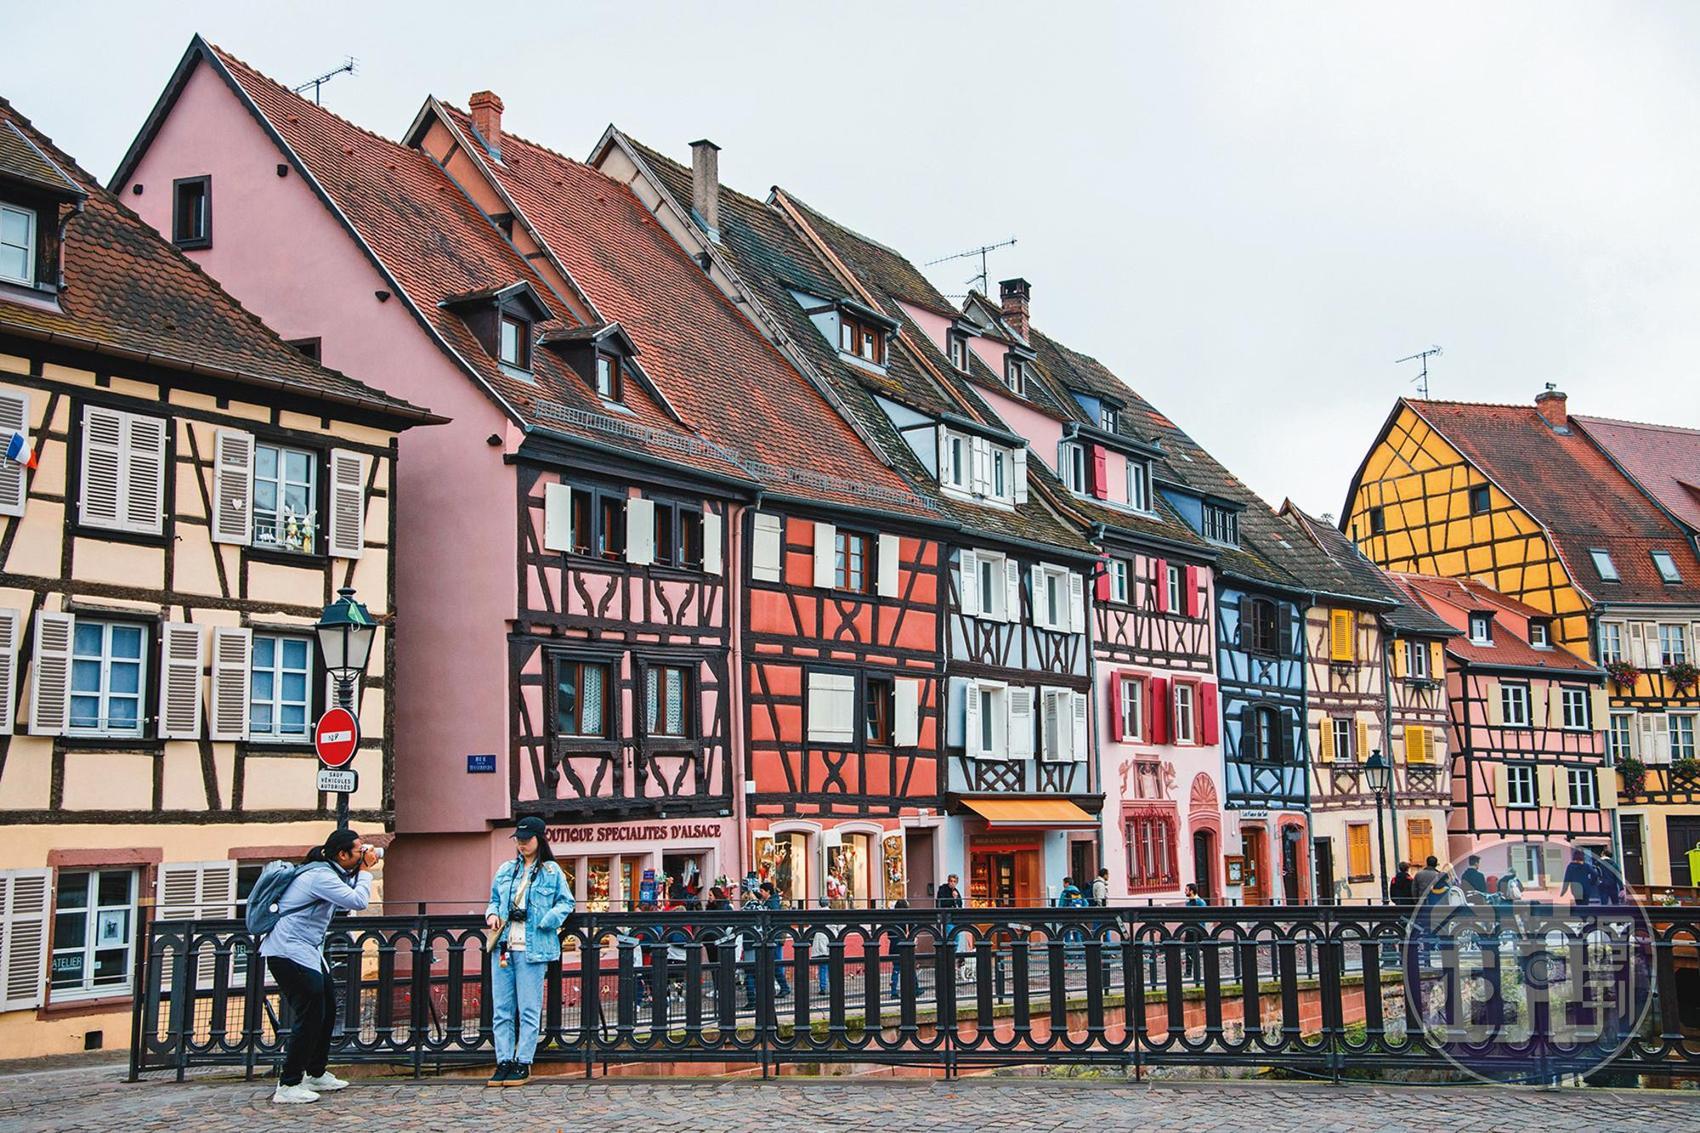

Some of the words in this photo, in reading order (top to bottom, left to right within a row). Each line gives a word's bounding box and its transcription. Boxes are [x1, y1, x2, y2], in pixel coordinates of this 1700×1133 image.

[545, 827, 594, 843] OUTIQUE
[597, 825, 668, 842] SPECIALITES
[671, 824, 721, 840] D'ALSACE
